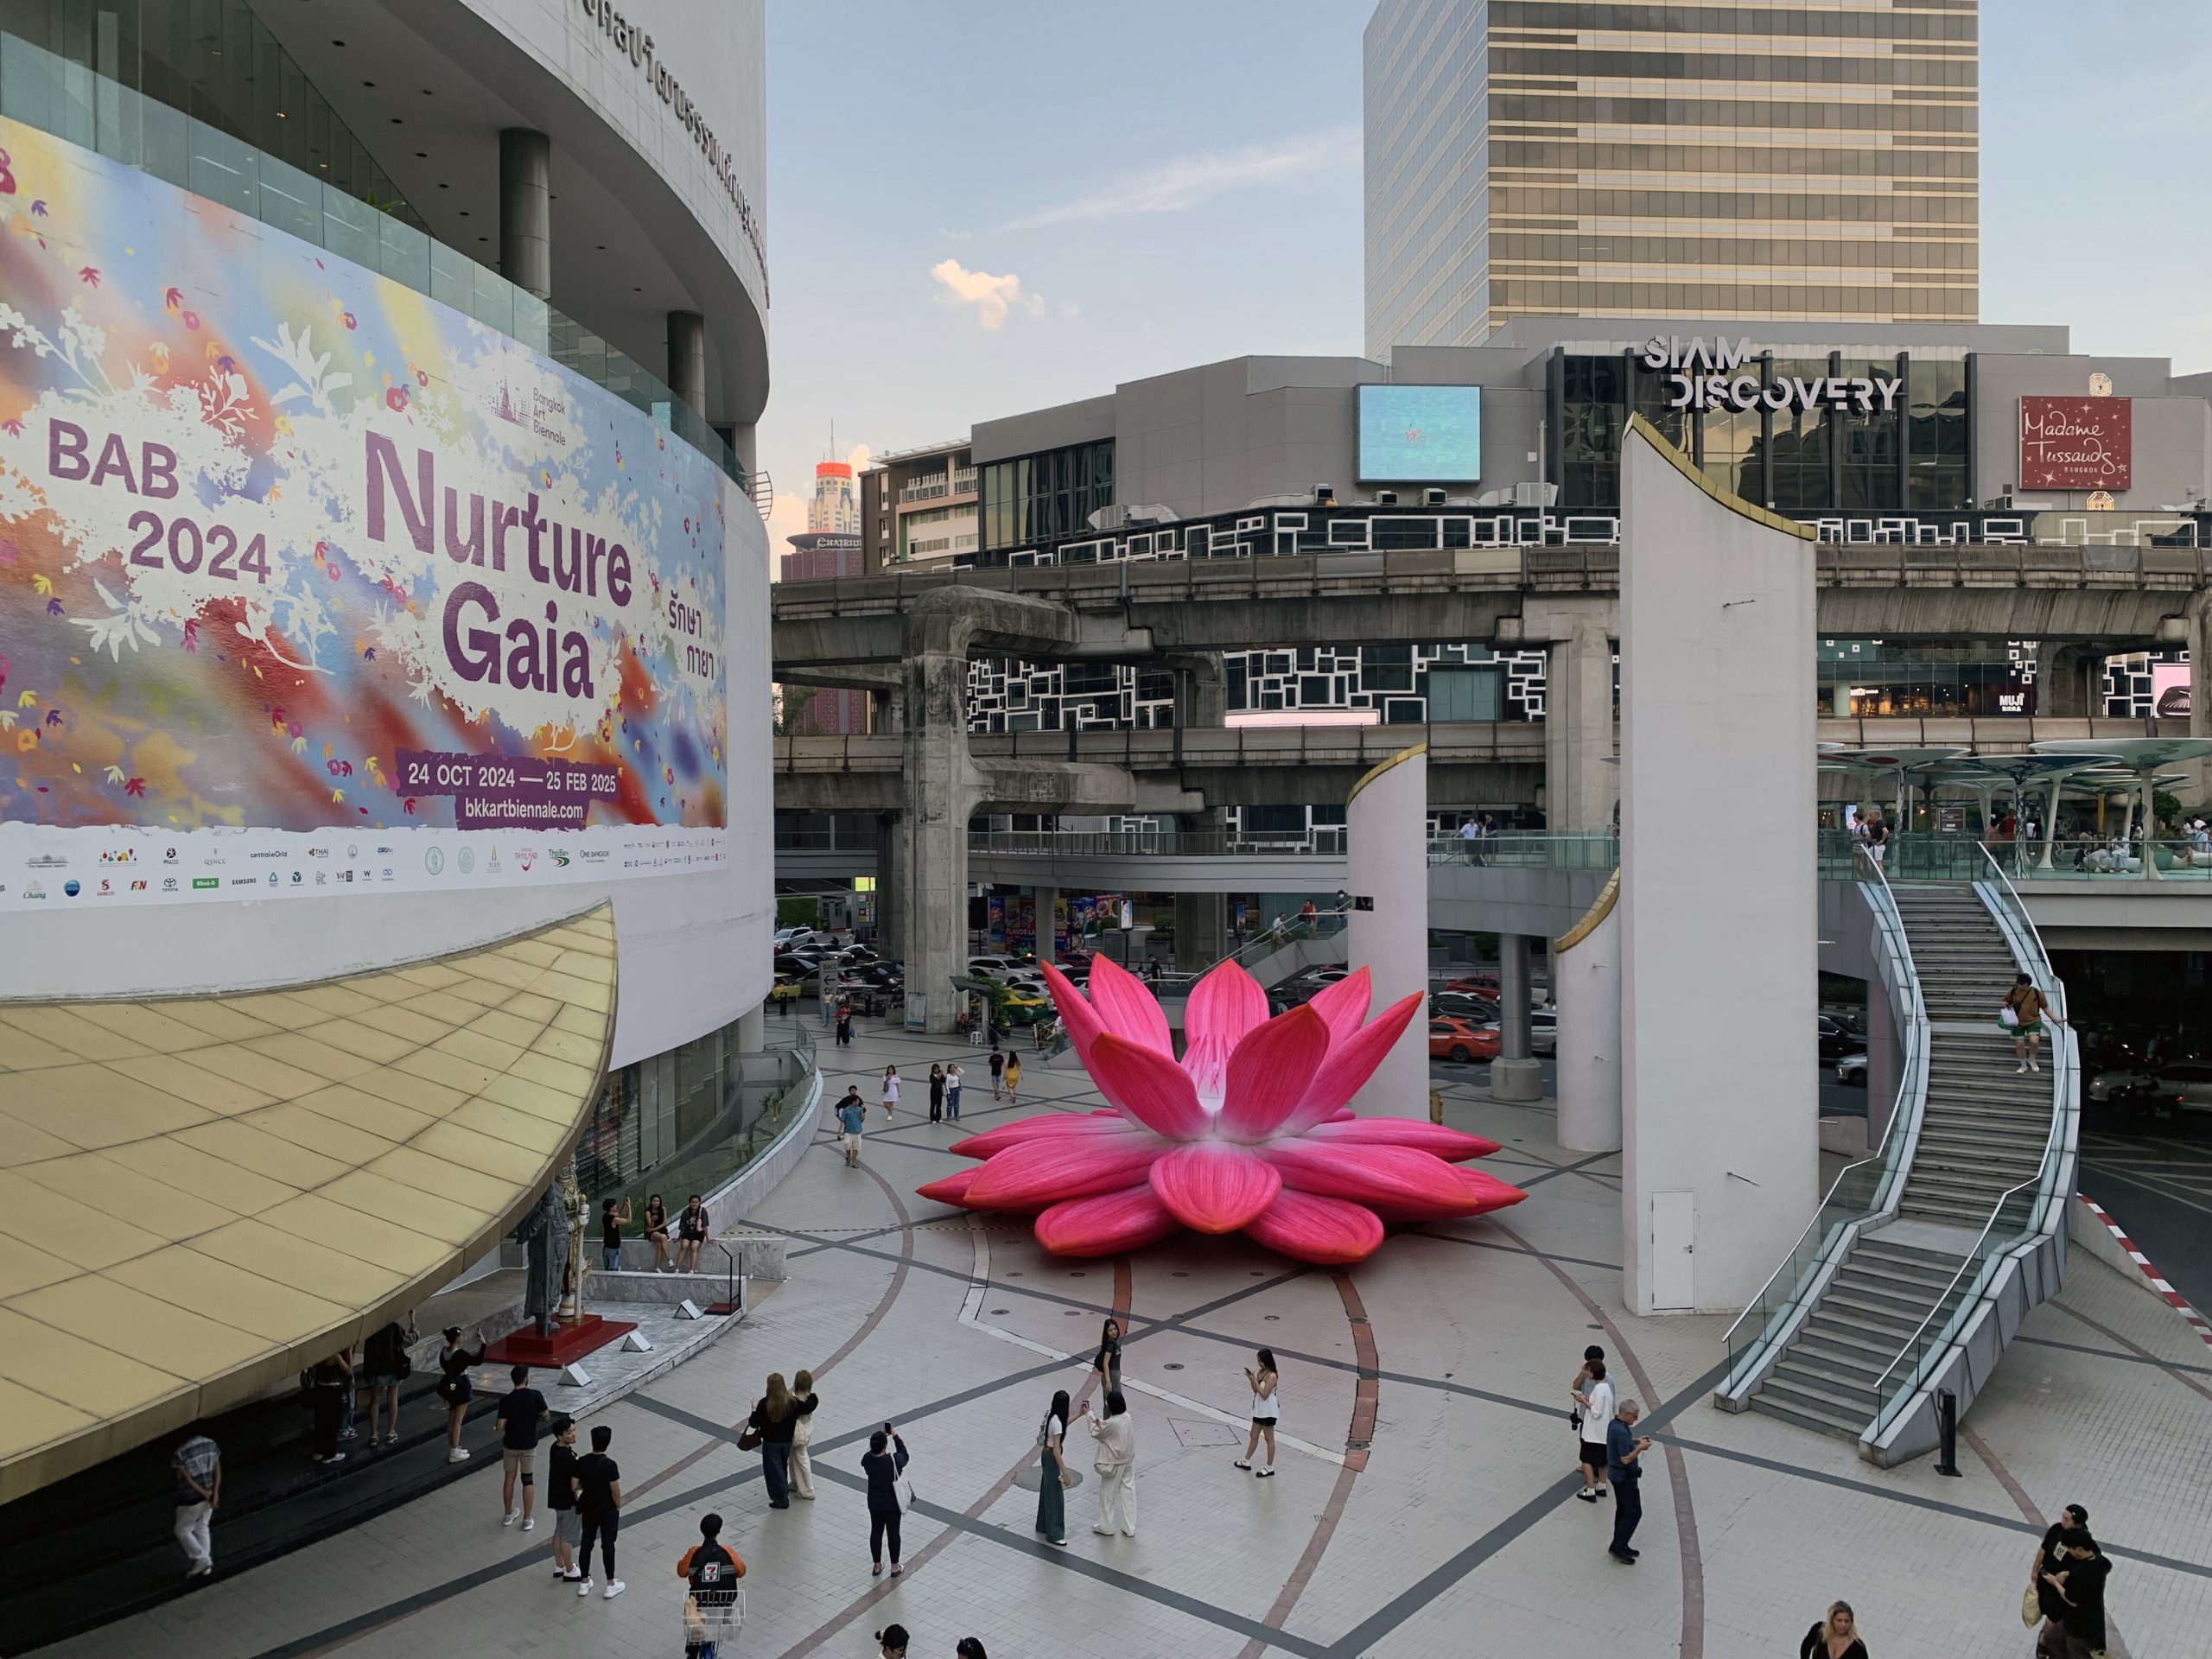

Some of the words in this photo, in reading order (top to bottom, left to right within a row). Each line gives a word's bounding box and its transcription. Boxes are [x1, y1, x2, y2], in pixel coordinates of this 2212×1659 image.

[1644, 335, 1751, 370] SIAM
[533, 387, 566, 416] Bangkok
[1670, 374, 1903, 410] DISCOVERY
[532, 404, 545, 422] Art
[2024, 410, 2105, 439] Madame
[533, 421, 566, 446] Biennale
[48, 417, 180, 499] BAB
[2026, 437, 2116, 474] Tussauds
[365, 429, 632, 607] Nurture
[128, 510, 271, 584] 2024
[817, 537, 861, 548] CHATRIU
[669, 590, 702, 639] รักษา
[442, 581, 594, 699] Gaia
[687, 645, 715, 680] กายา
[1999, 694, 2024, 706] MUJI
[408, 762, 429, 785] 24
[437, 766, 472, 786] OCT
[479, 766, 515, 788] 2024
[546, 771, 561, 790] 25
[566, 772, 587, 791] FEB
[591, 774, 616, 793] 2025
[465, 798, 583, 819] bkkartbiennale.com
[548, 849, 569, 857] ThaiBev
